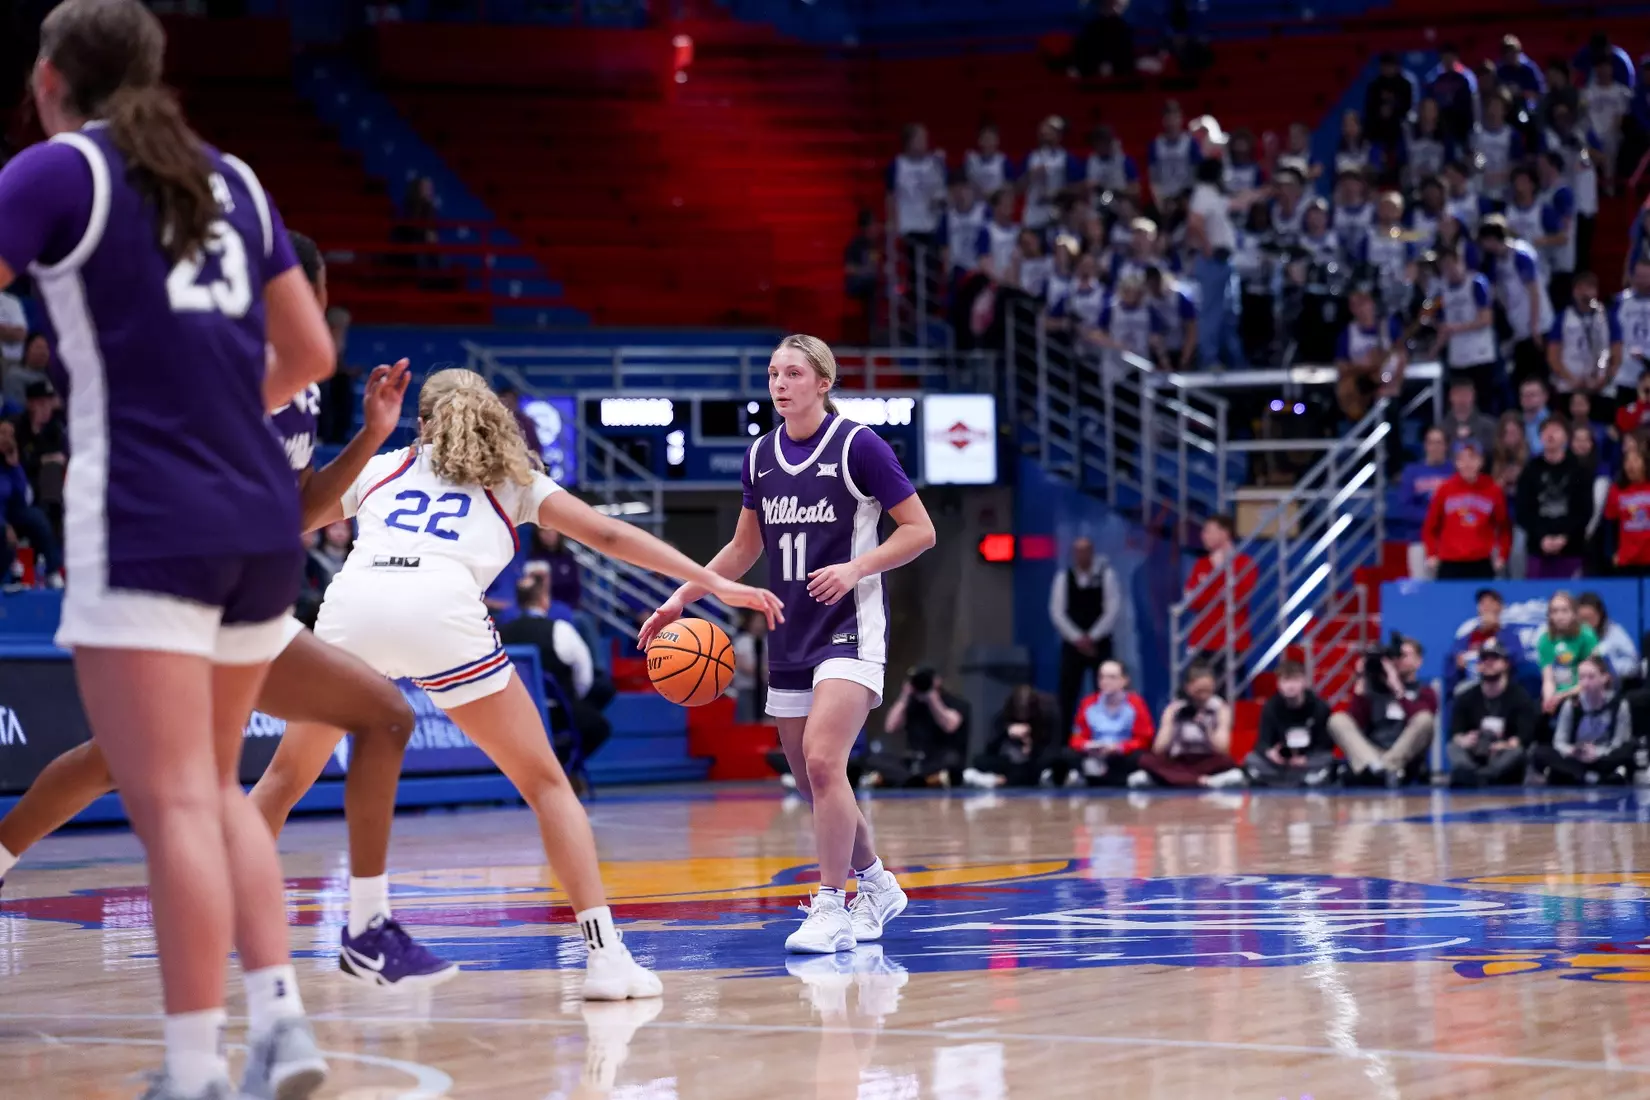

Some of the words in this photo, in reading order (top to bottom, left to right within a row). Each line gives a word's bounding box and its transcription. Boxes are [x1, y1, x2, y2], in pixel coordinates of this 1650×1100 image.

[163, 220, 252, 318] 23
[384, 490, 471, 541] 22
[761, 495, 838, 525] Wildcats
[778, 532, 807, 581] 11
